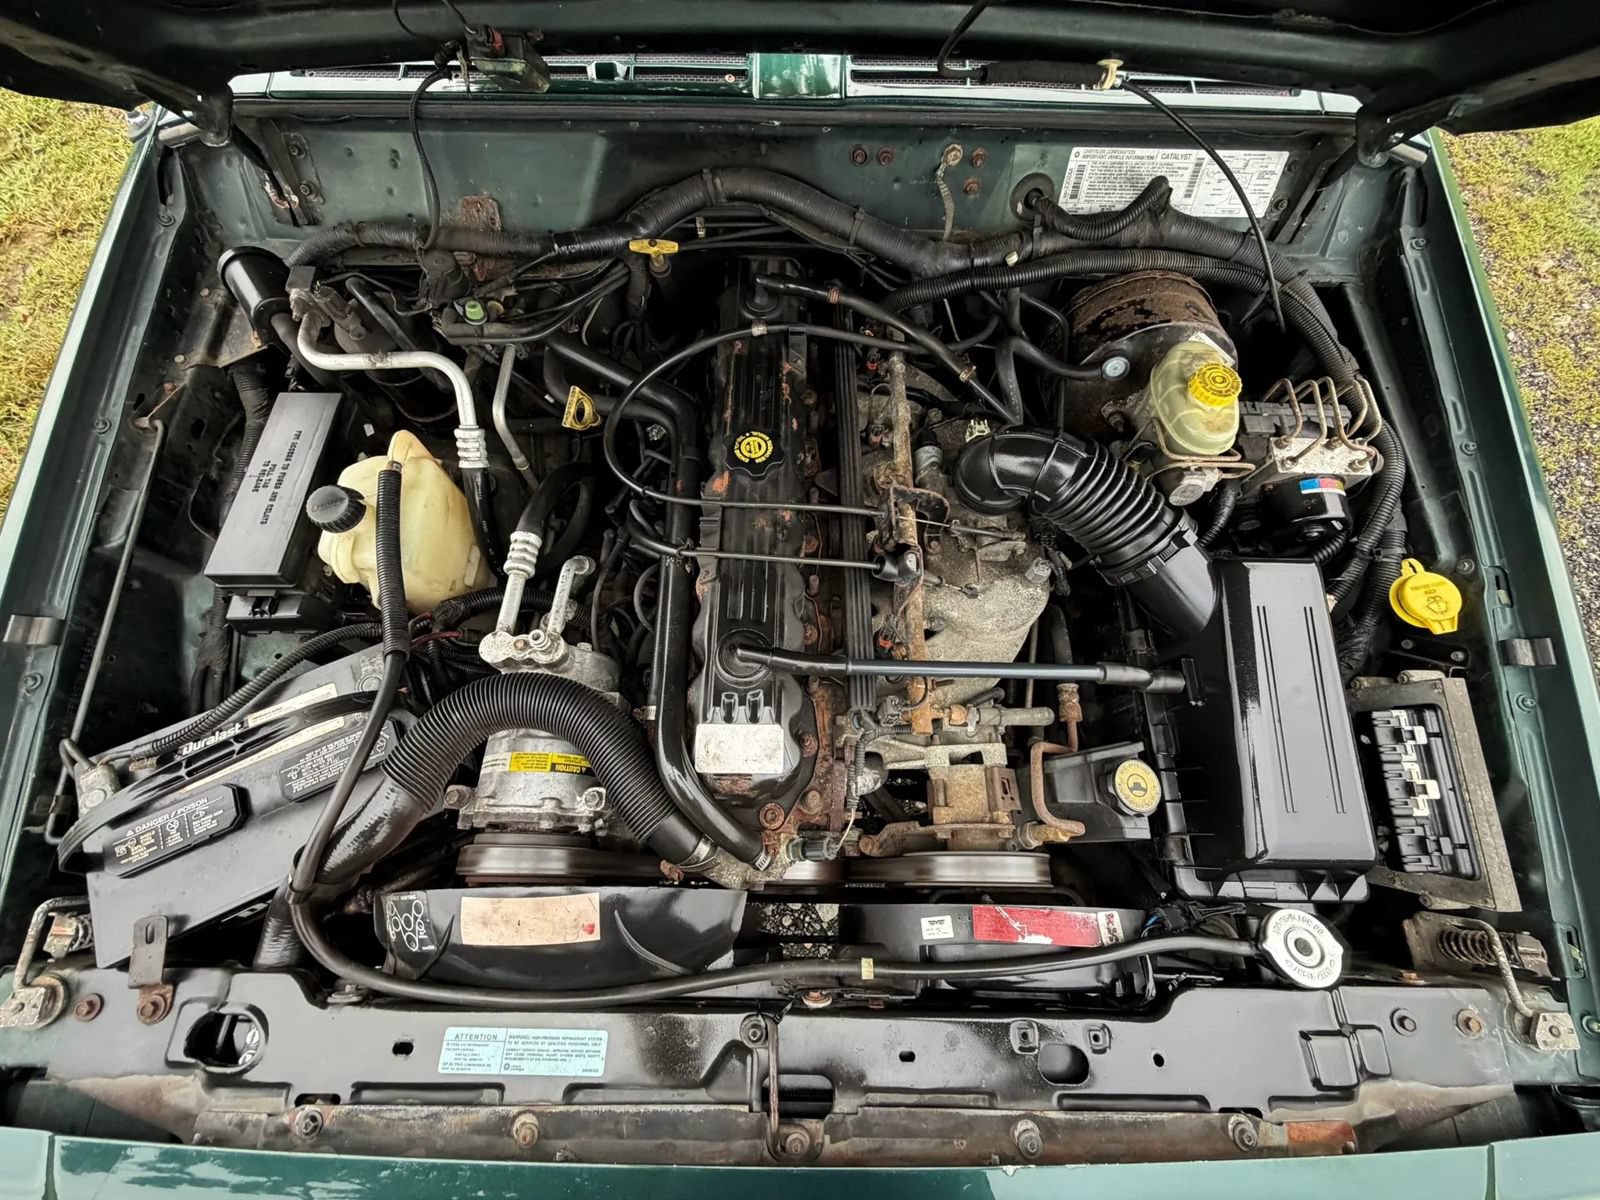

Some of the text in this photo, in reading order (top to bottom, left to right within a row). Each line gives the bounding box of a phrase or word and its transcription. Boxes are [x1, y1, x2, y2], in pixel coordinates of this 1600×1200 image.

[180, 722, 242, 755] Duralast
[555, 763, 581, 774] CAUTION
[135, 814, 170, 833] DANGER
[177, 797, 208, 814] POISON
